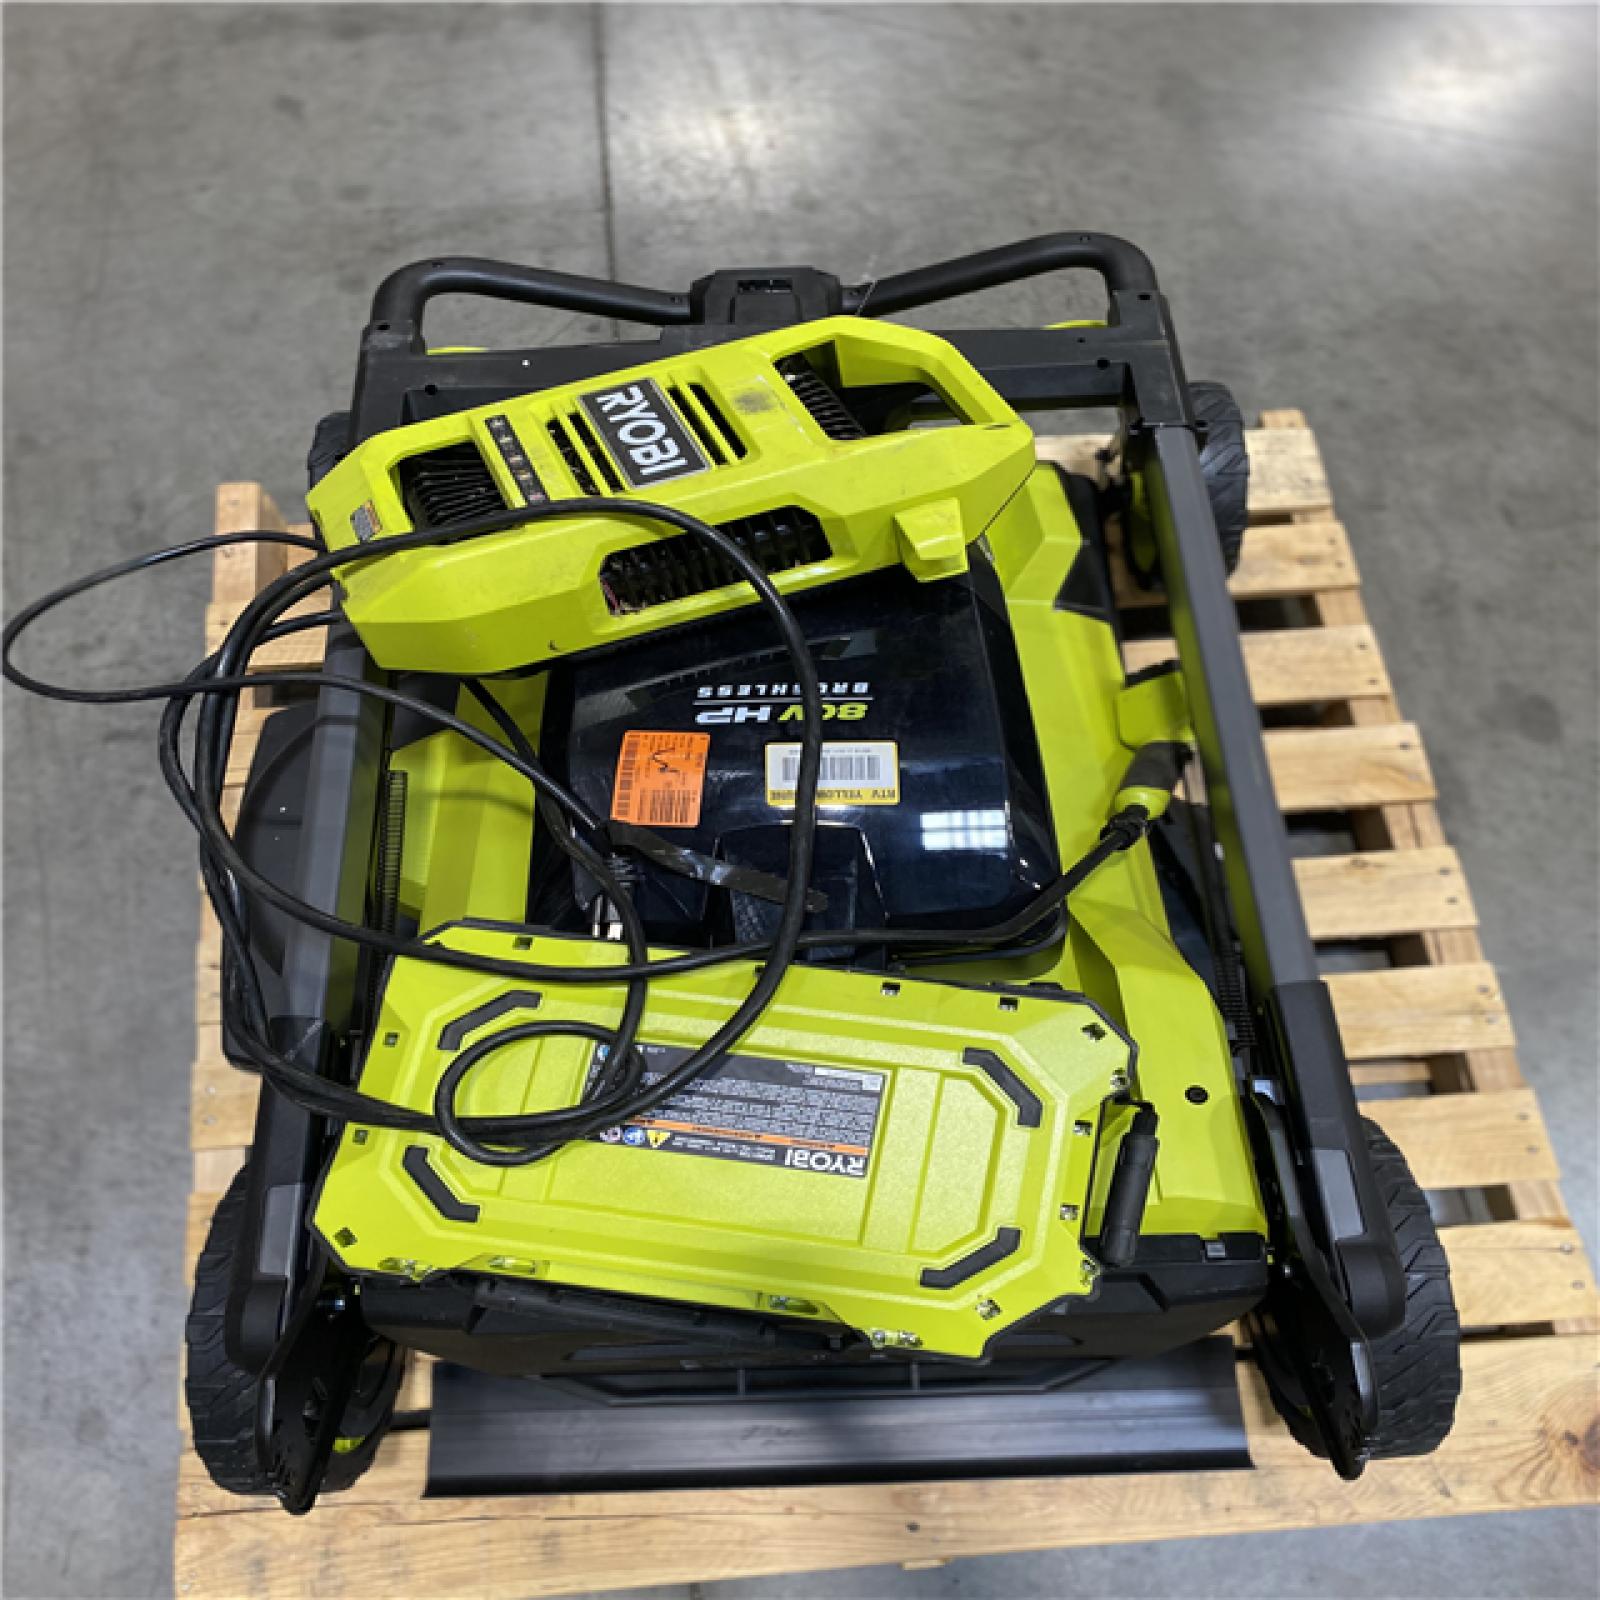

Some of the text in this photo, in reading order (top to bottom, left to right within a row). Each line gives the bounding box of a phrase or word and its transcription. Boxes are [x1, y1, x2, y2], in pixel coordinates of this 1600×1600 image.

[594, 385, 688, 476] RYOBI
[695, 706, 771, 723] HP
[785, 1149, 865, 1176] RYOBI
